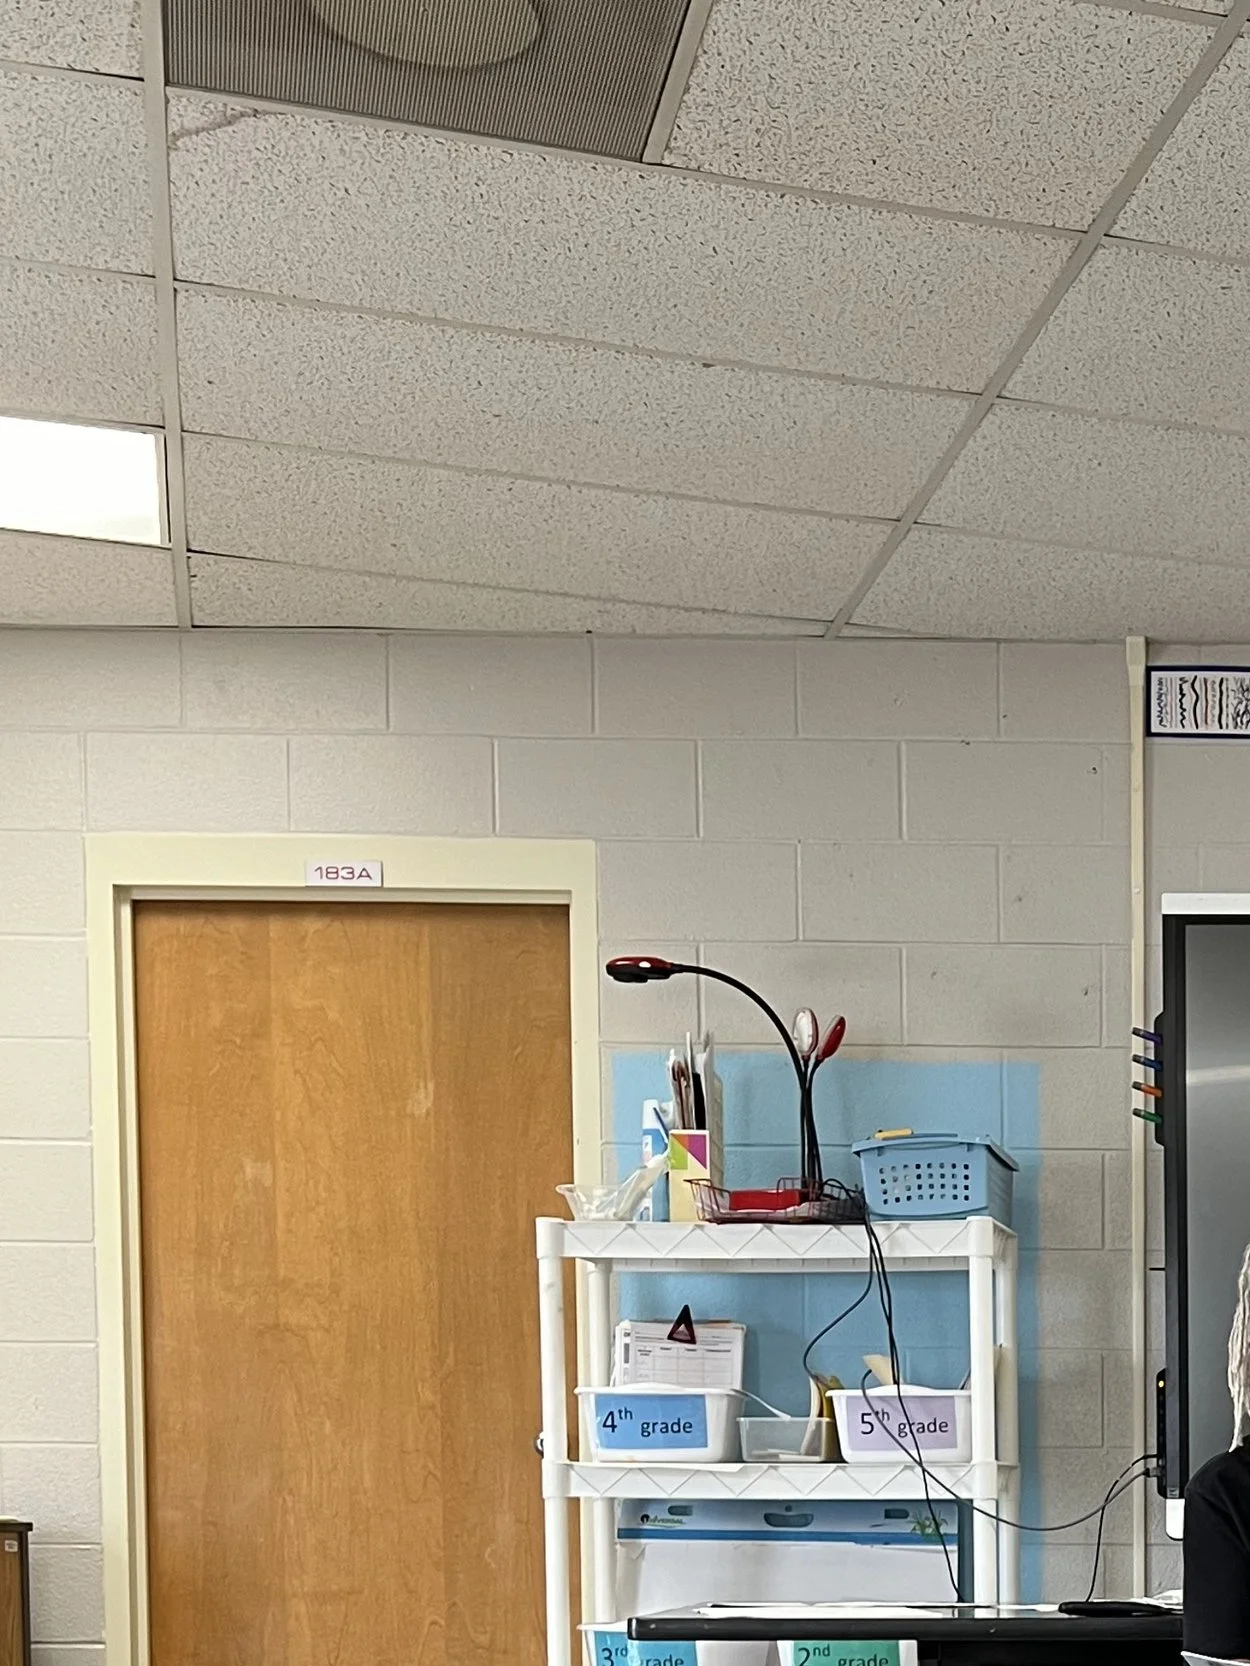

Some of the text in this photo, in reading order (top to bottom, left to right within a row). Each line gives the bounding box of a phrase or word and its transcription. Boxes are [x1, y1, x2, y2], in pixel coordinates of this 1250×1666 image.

[314, 866, 372, 880] 183A
[602, 1407, 693, 1437] 4th grade
[898, 1417, 949, 1438] grade
